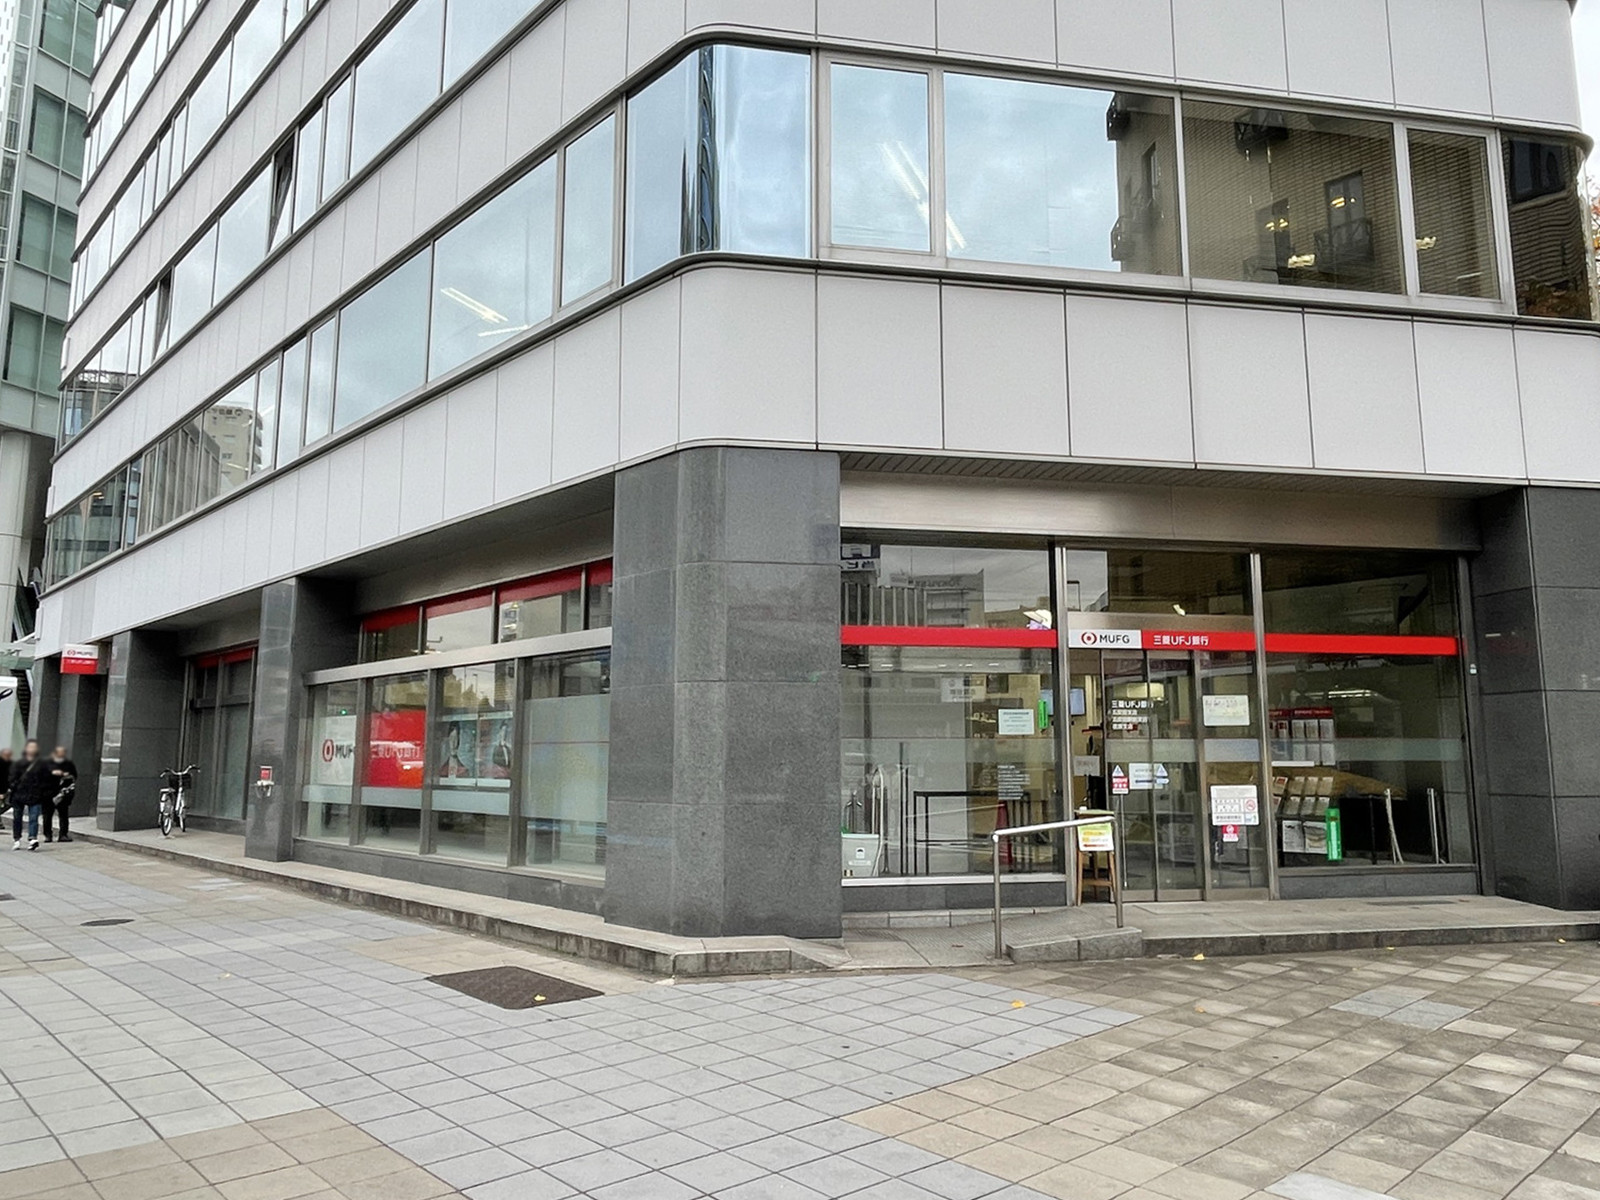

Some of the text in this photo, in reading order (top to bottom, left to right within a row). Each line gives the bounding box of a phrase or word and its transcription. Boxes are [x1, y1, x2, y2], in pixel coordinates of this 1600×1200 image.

[1099, 634, 1130, 644] MUFG
[1153, 635, 1209, 646] 三菱UFJ銀行
[335, 744, 354, 759] MUF
